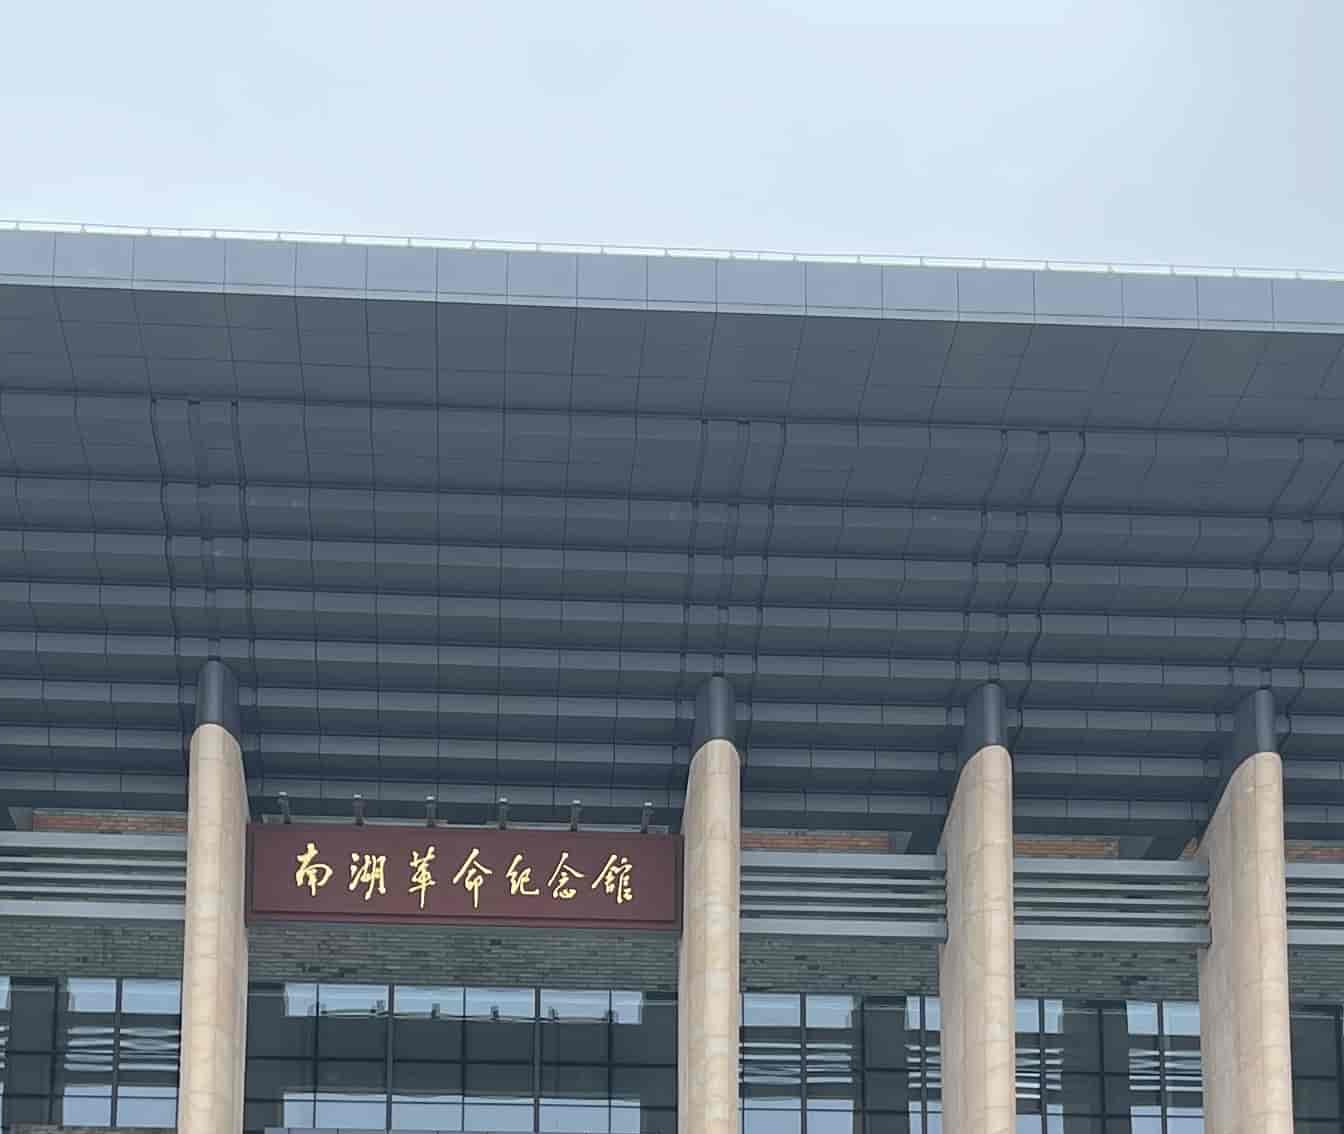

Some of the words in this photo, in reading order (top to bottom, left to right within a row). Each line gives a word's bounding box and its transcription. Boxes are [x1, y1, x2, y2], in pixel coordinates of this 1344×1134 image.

[294, 842, 633, 908] 南湖革命纪念馆
